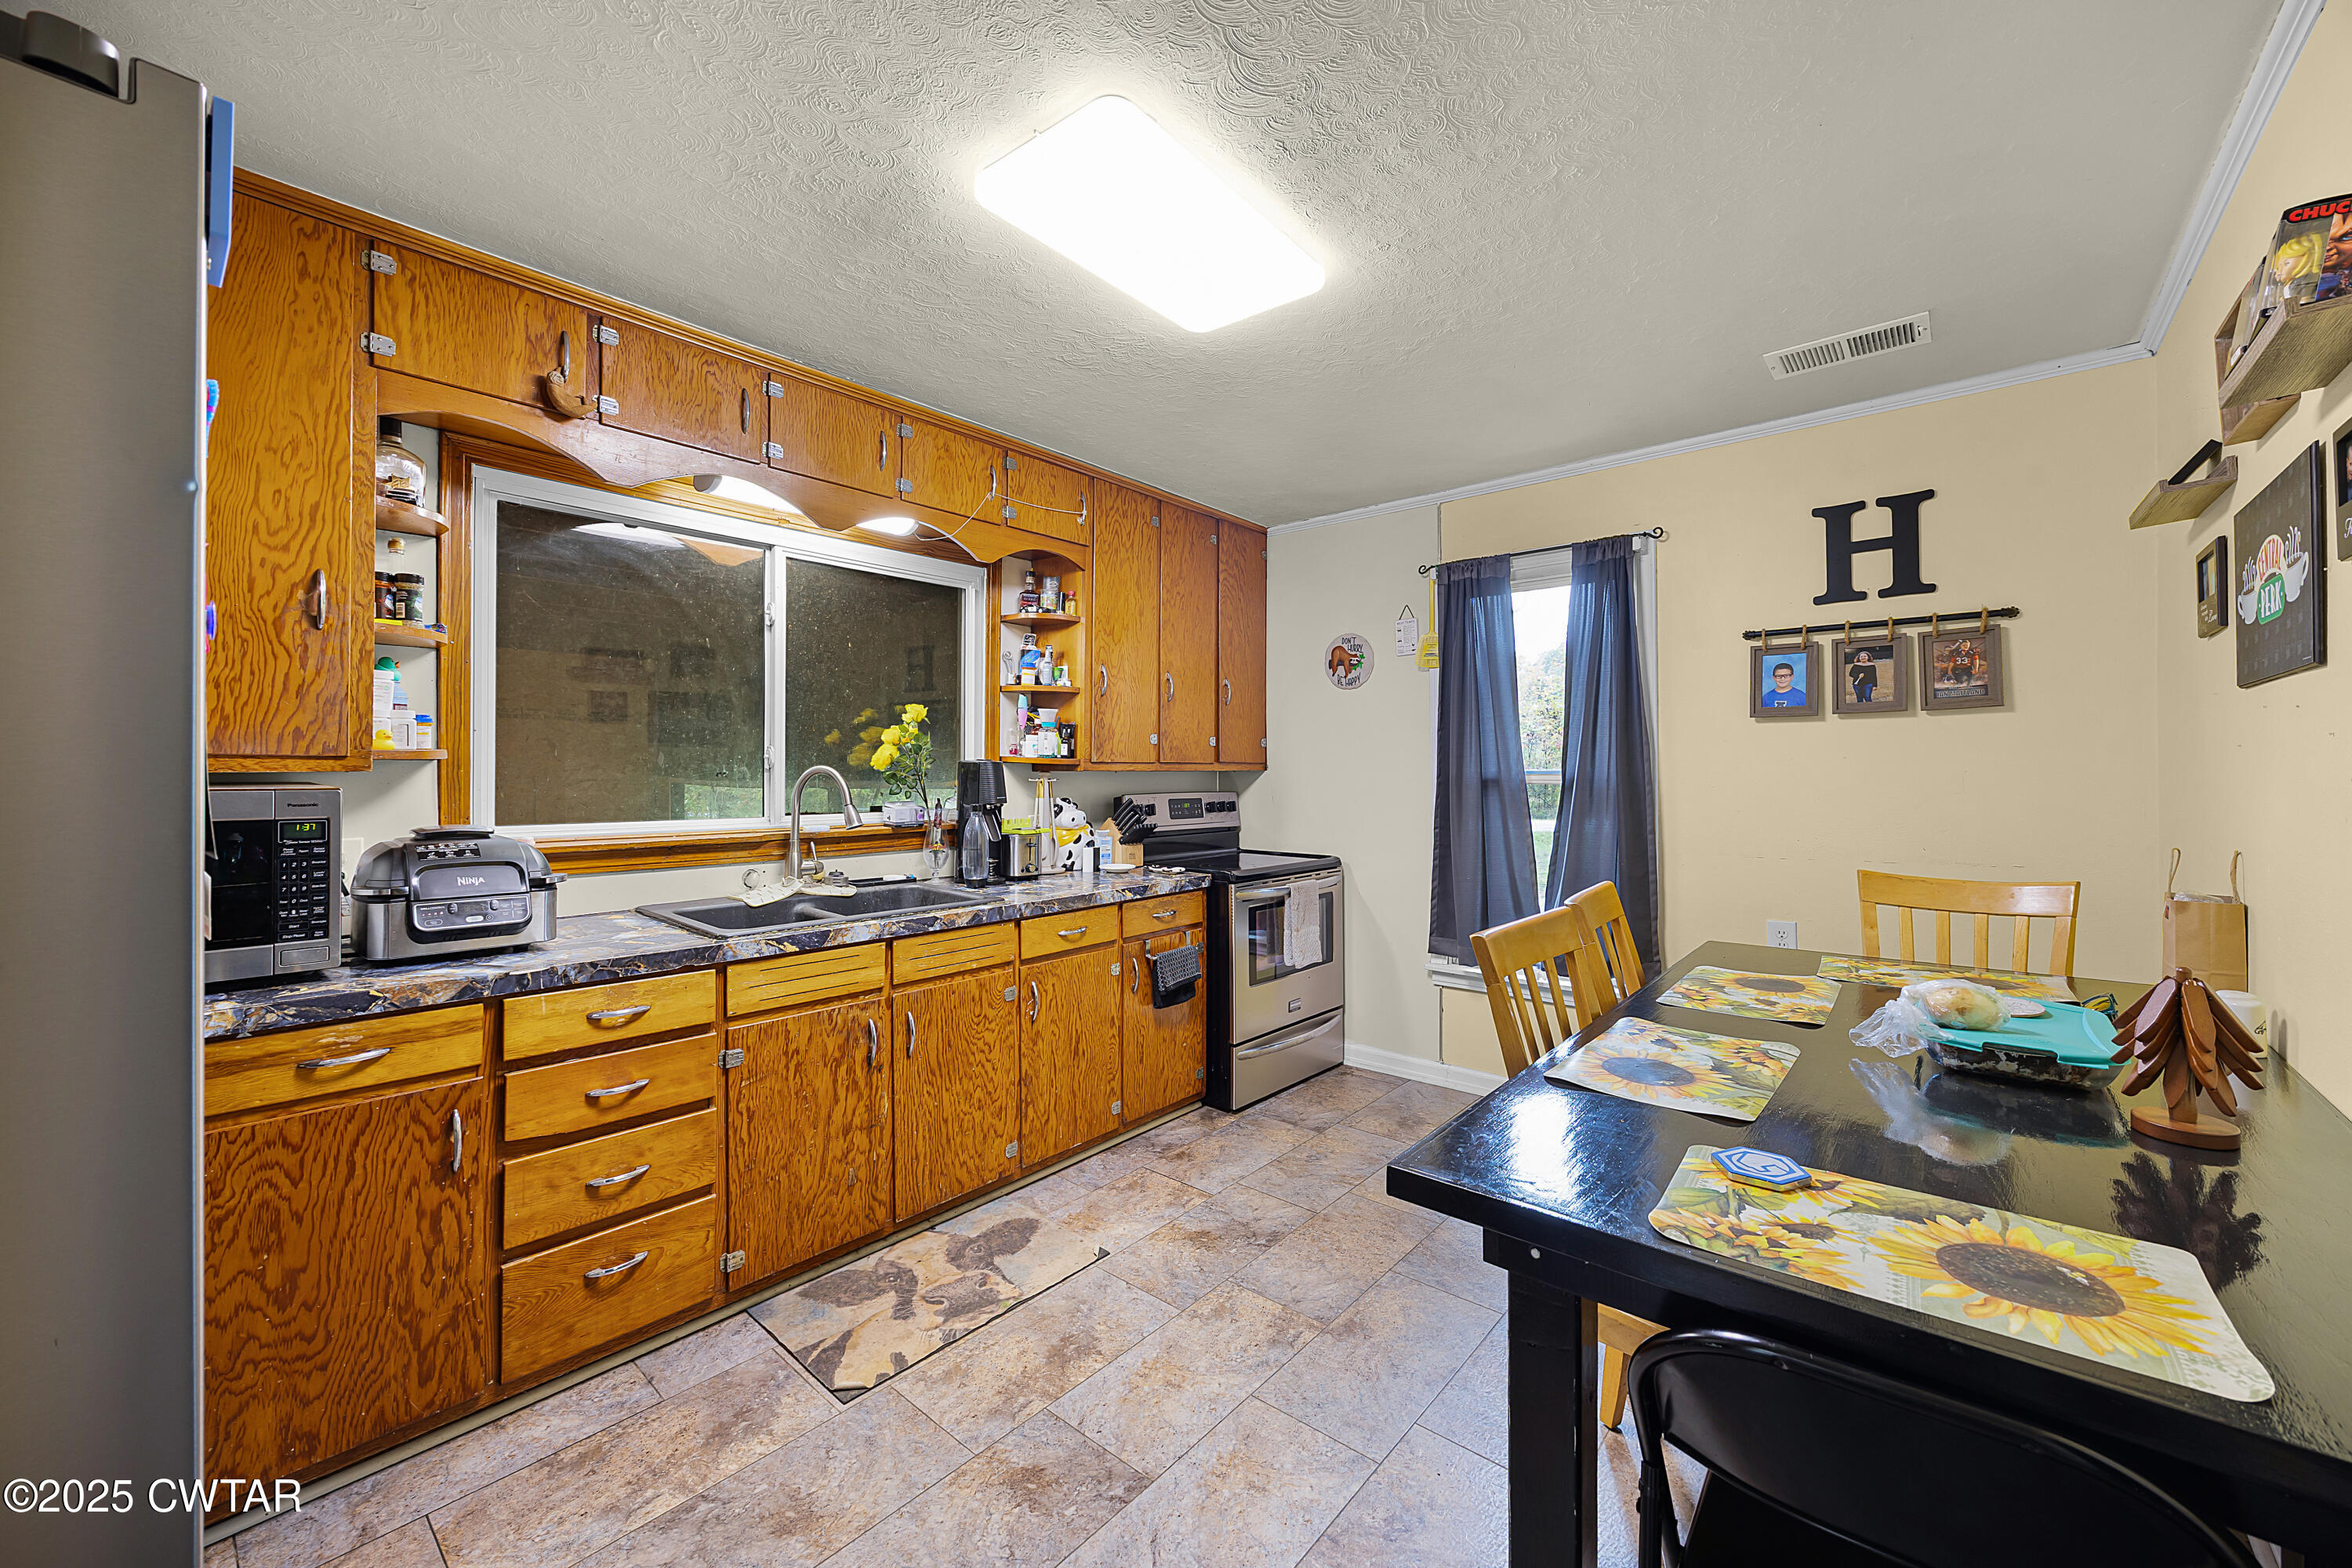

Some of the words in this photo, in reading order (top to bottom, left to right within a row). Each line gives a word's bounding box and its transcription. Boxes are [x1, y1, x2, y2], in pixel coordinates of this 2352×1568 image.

[2288, 200, 2352, 222] CHUC
[1811, 488, 1936, 606] H
[2258, 537, 2282, 582] CENTRAL
[2260, 580, 2282, 619] PERK
[1347, 644, 1363, 653] HURRY
[1337, 673, 1345, 686] BE
[1345, 672, 1361, 687] HAPPY
[457, 877, 486, 887] NINJA
